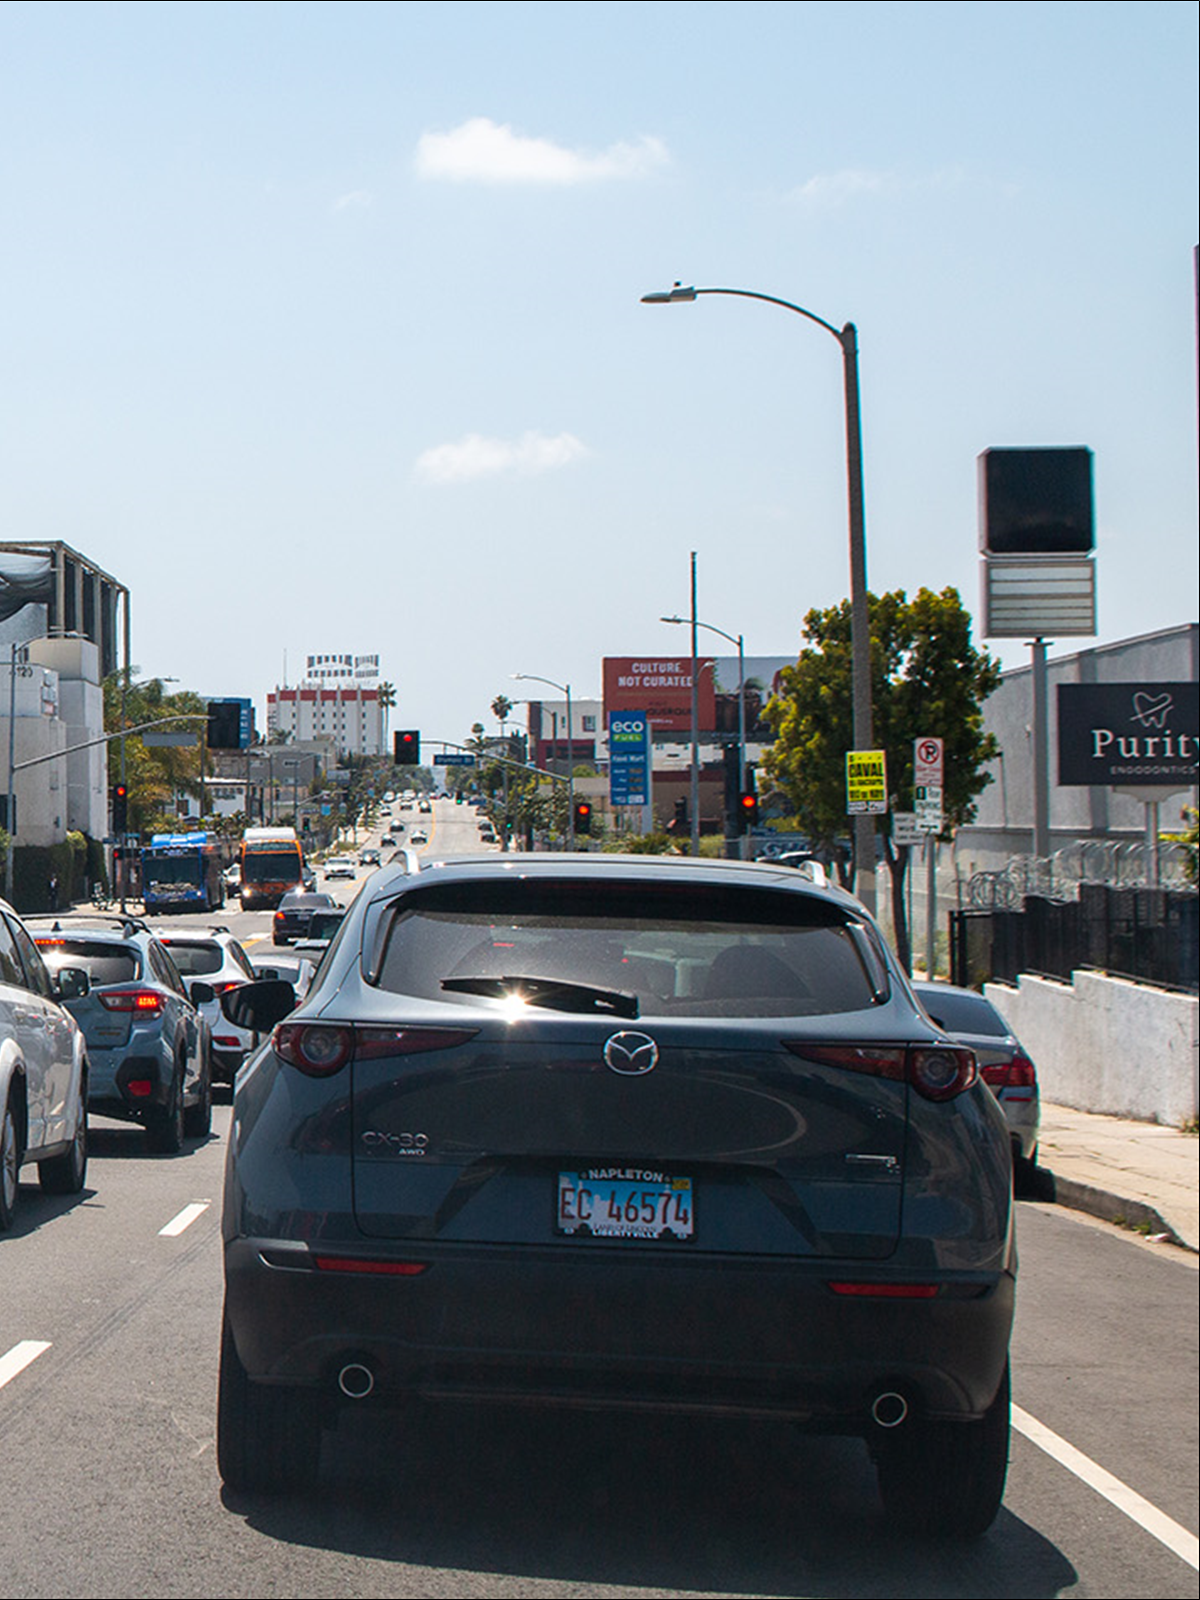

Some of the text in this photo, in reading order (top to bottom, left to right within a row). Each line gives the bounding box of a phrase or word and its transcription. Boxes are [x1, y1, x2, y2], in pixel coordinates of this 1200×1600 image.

[618, 676, 640, 687] NOT
[611, 721, 644, 733] eco
[1110, 766, 1196, 775] ENDODONTICS
[362, 1131, 429, 1148] CX-30
[399, 1148, 426, 1156] AWD
[588, 1168, 664, 1183] NAPLETON
[560, 1187, 689, 1226] EC 46574
